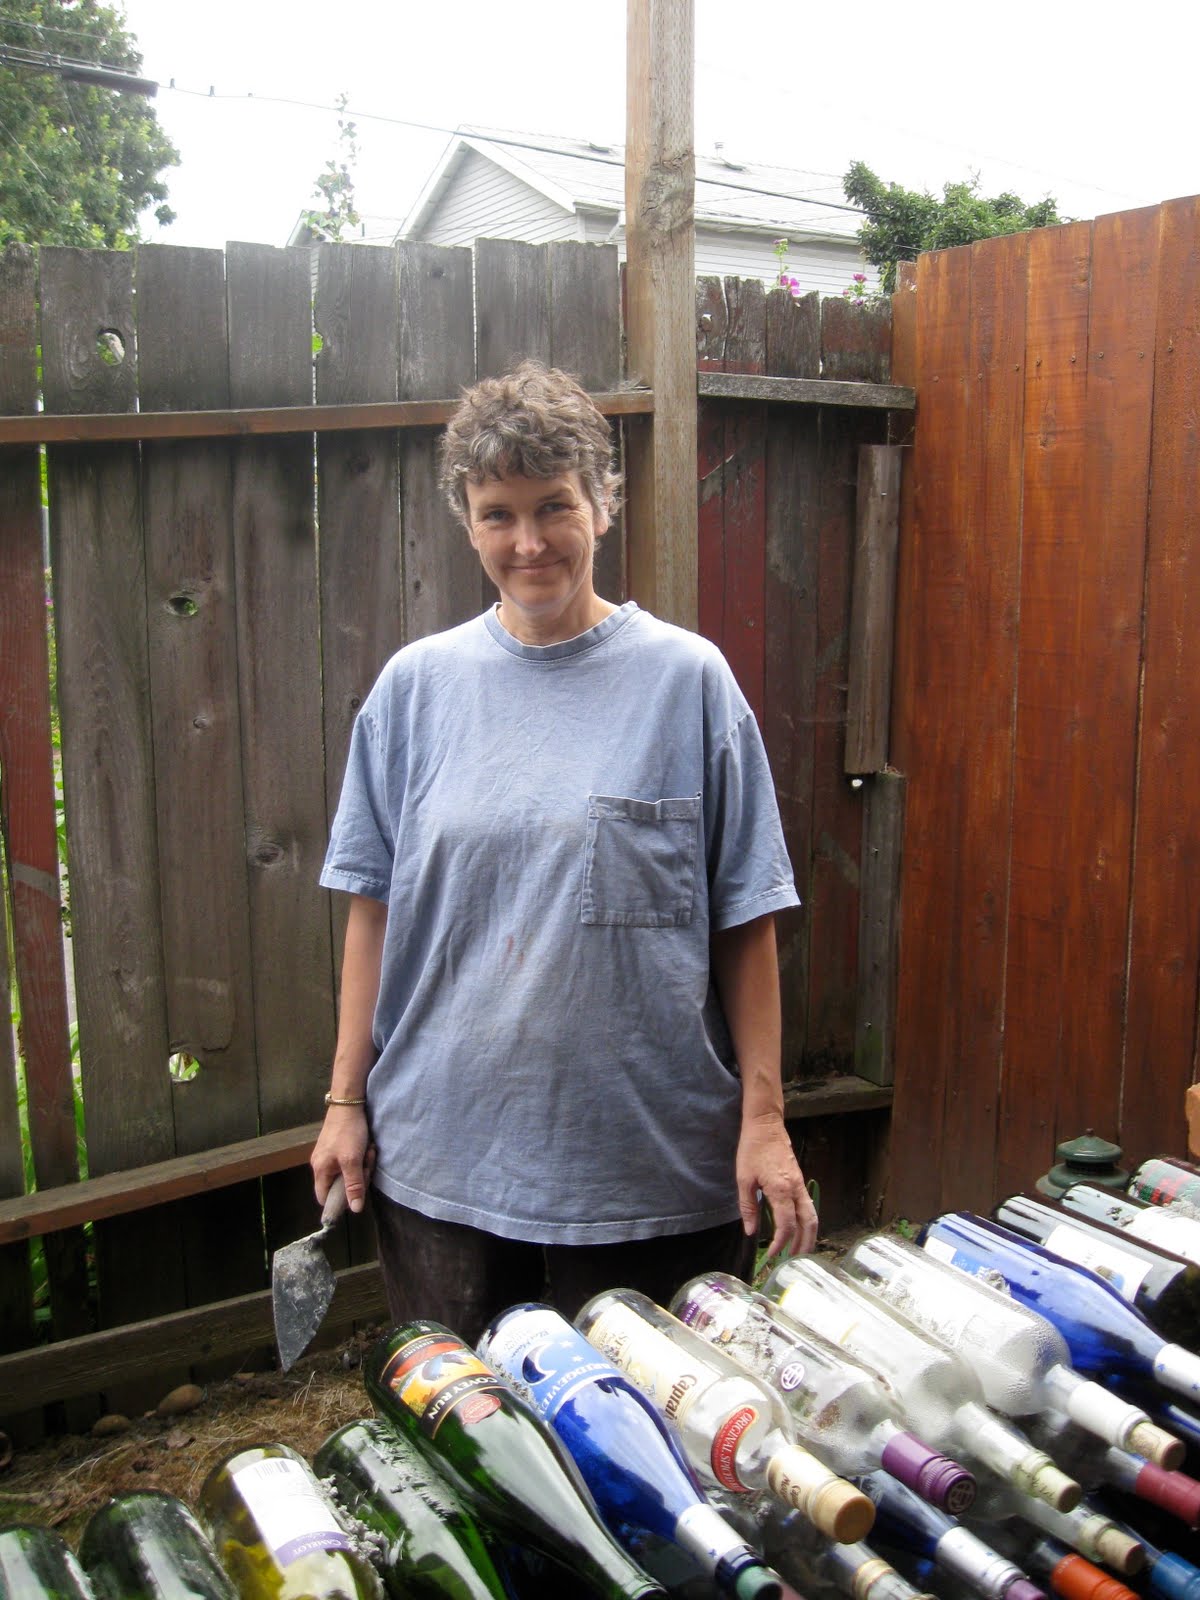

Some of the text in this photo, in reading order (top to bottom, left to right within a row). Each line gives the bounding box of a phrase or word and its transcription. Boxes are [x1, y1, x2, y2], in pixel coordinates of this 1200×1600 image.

[453, 1377, 498, 1394] COVEY
[427, 1392, 453, 1420] RUN
[721, 1412, 753, 1453] ORIGINAL
[293, 1540, 342, 1555] CAMELOT
